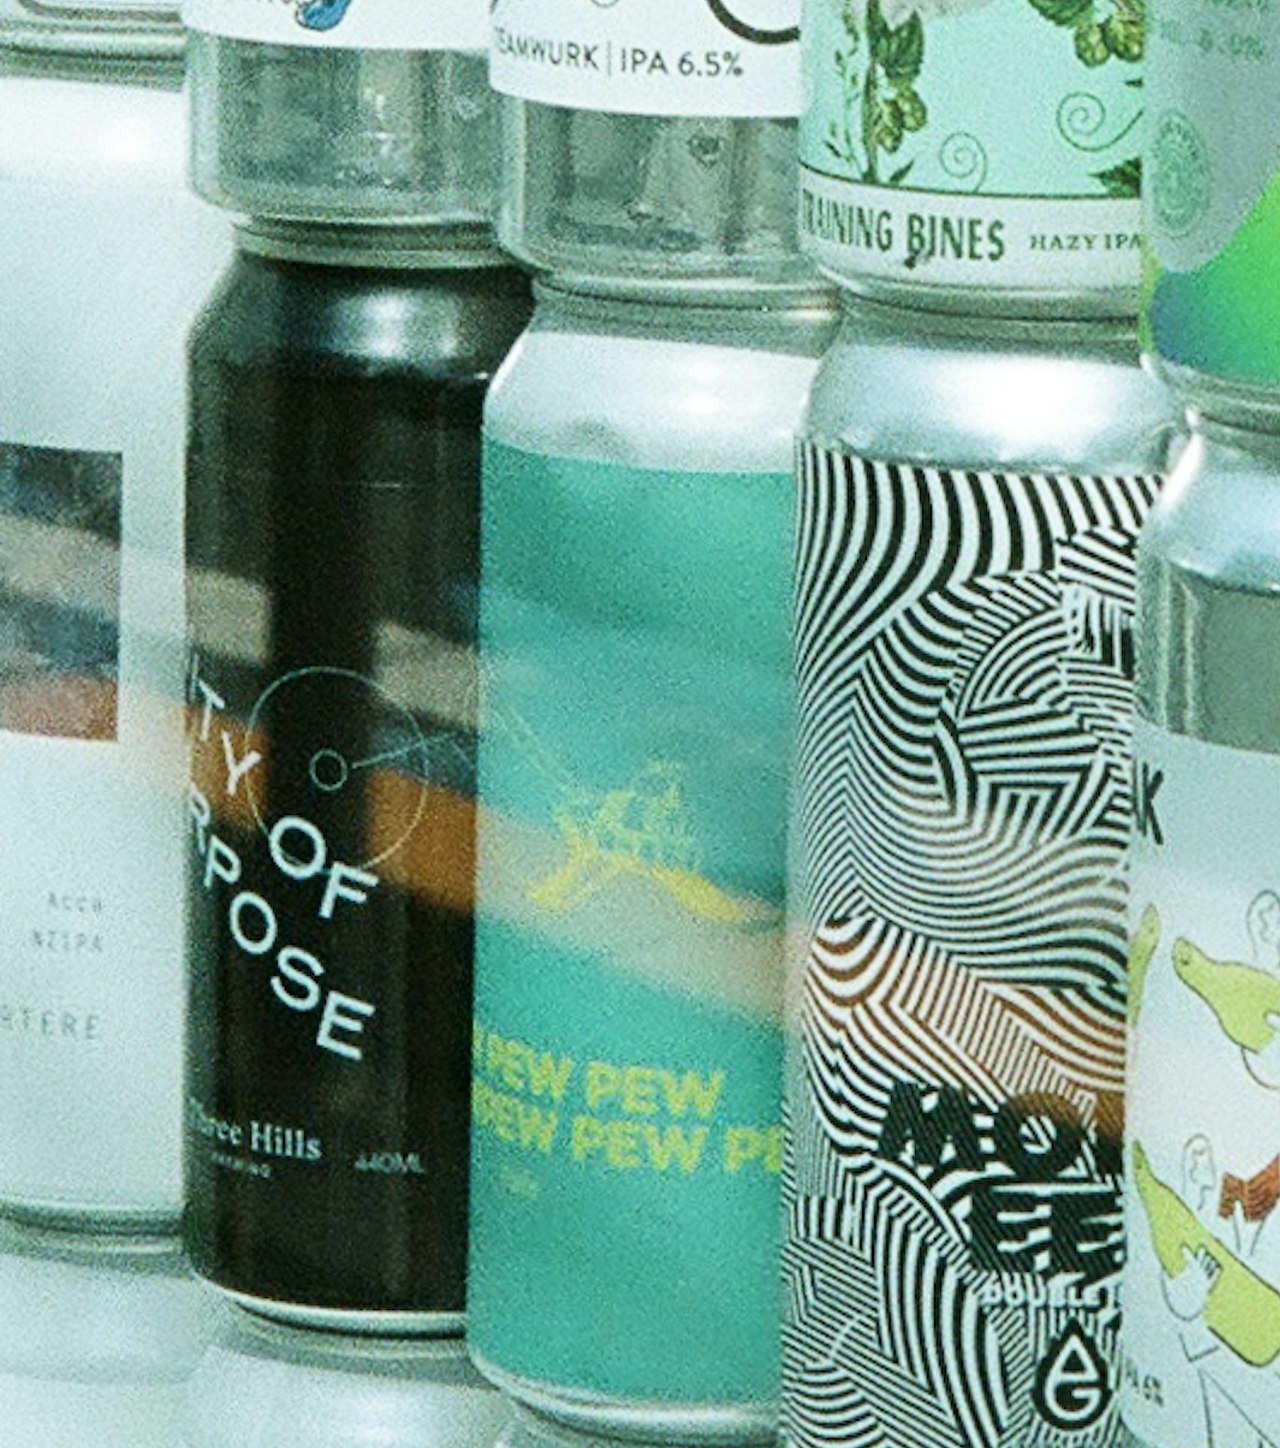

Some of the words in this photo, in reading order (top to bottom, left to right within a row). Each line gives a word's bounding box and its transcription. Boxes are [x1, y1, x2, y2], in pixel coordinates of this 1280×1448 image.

[620, 47, 669, 75] IPA
[677, 48, 744, 77] 6.5%
[905, 212, 1006, 269] BINES
[1029, 232, 1094, 251] HAZY
[1103, 232, 1143, 251] IPA
[586, 1059, 726, 1120] PEW
[249, 1118, 322, 1161] Hills
[571, 1113, 709, 1176] PEW
